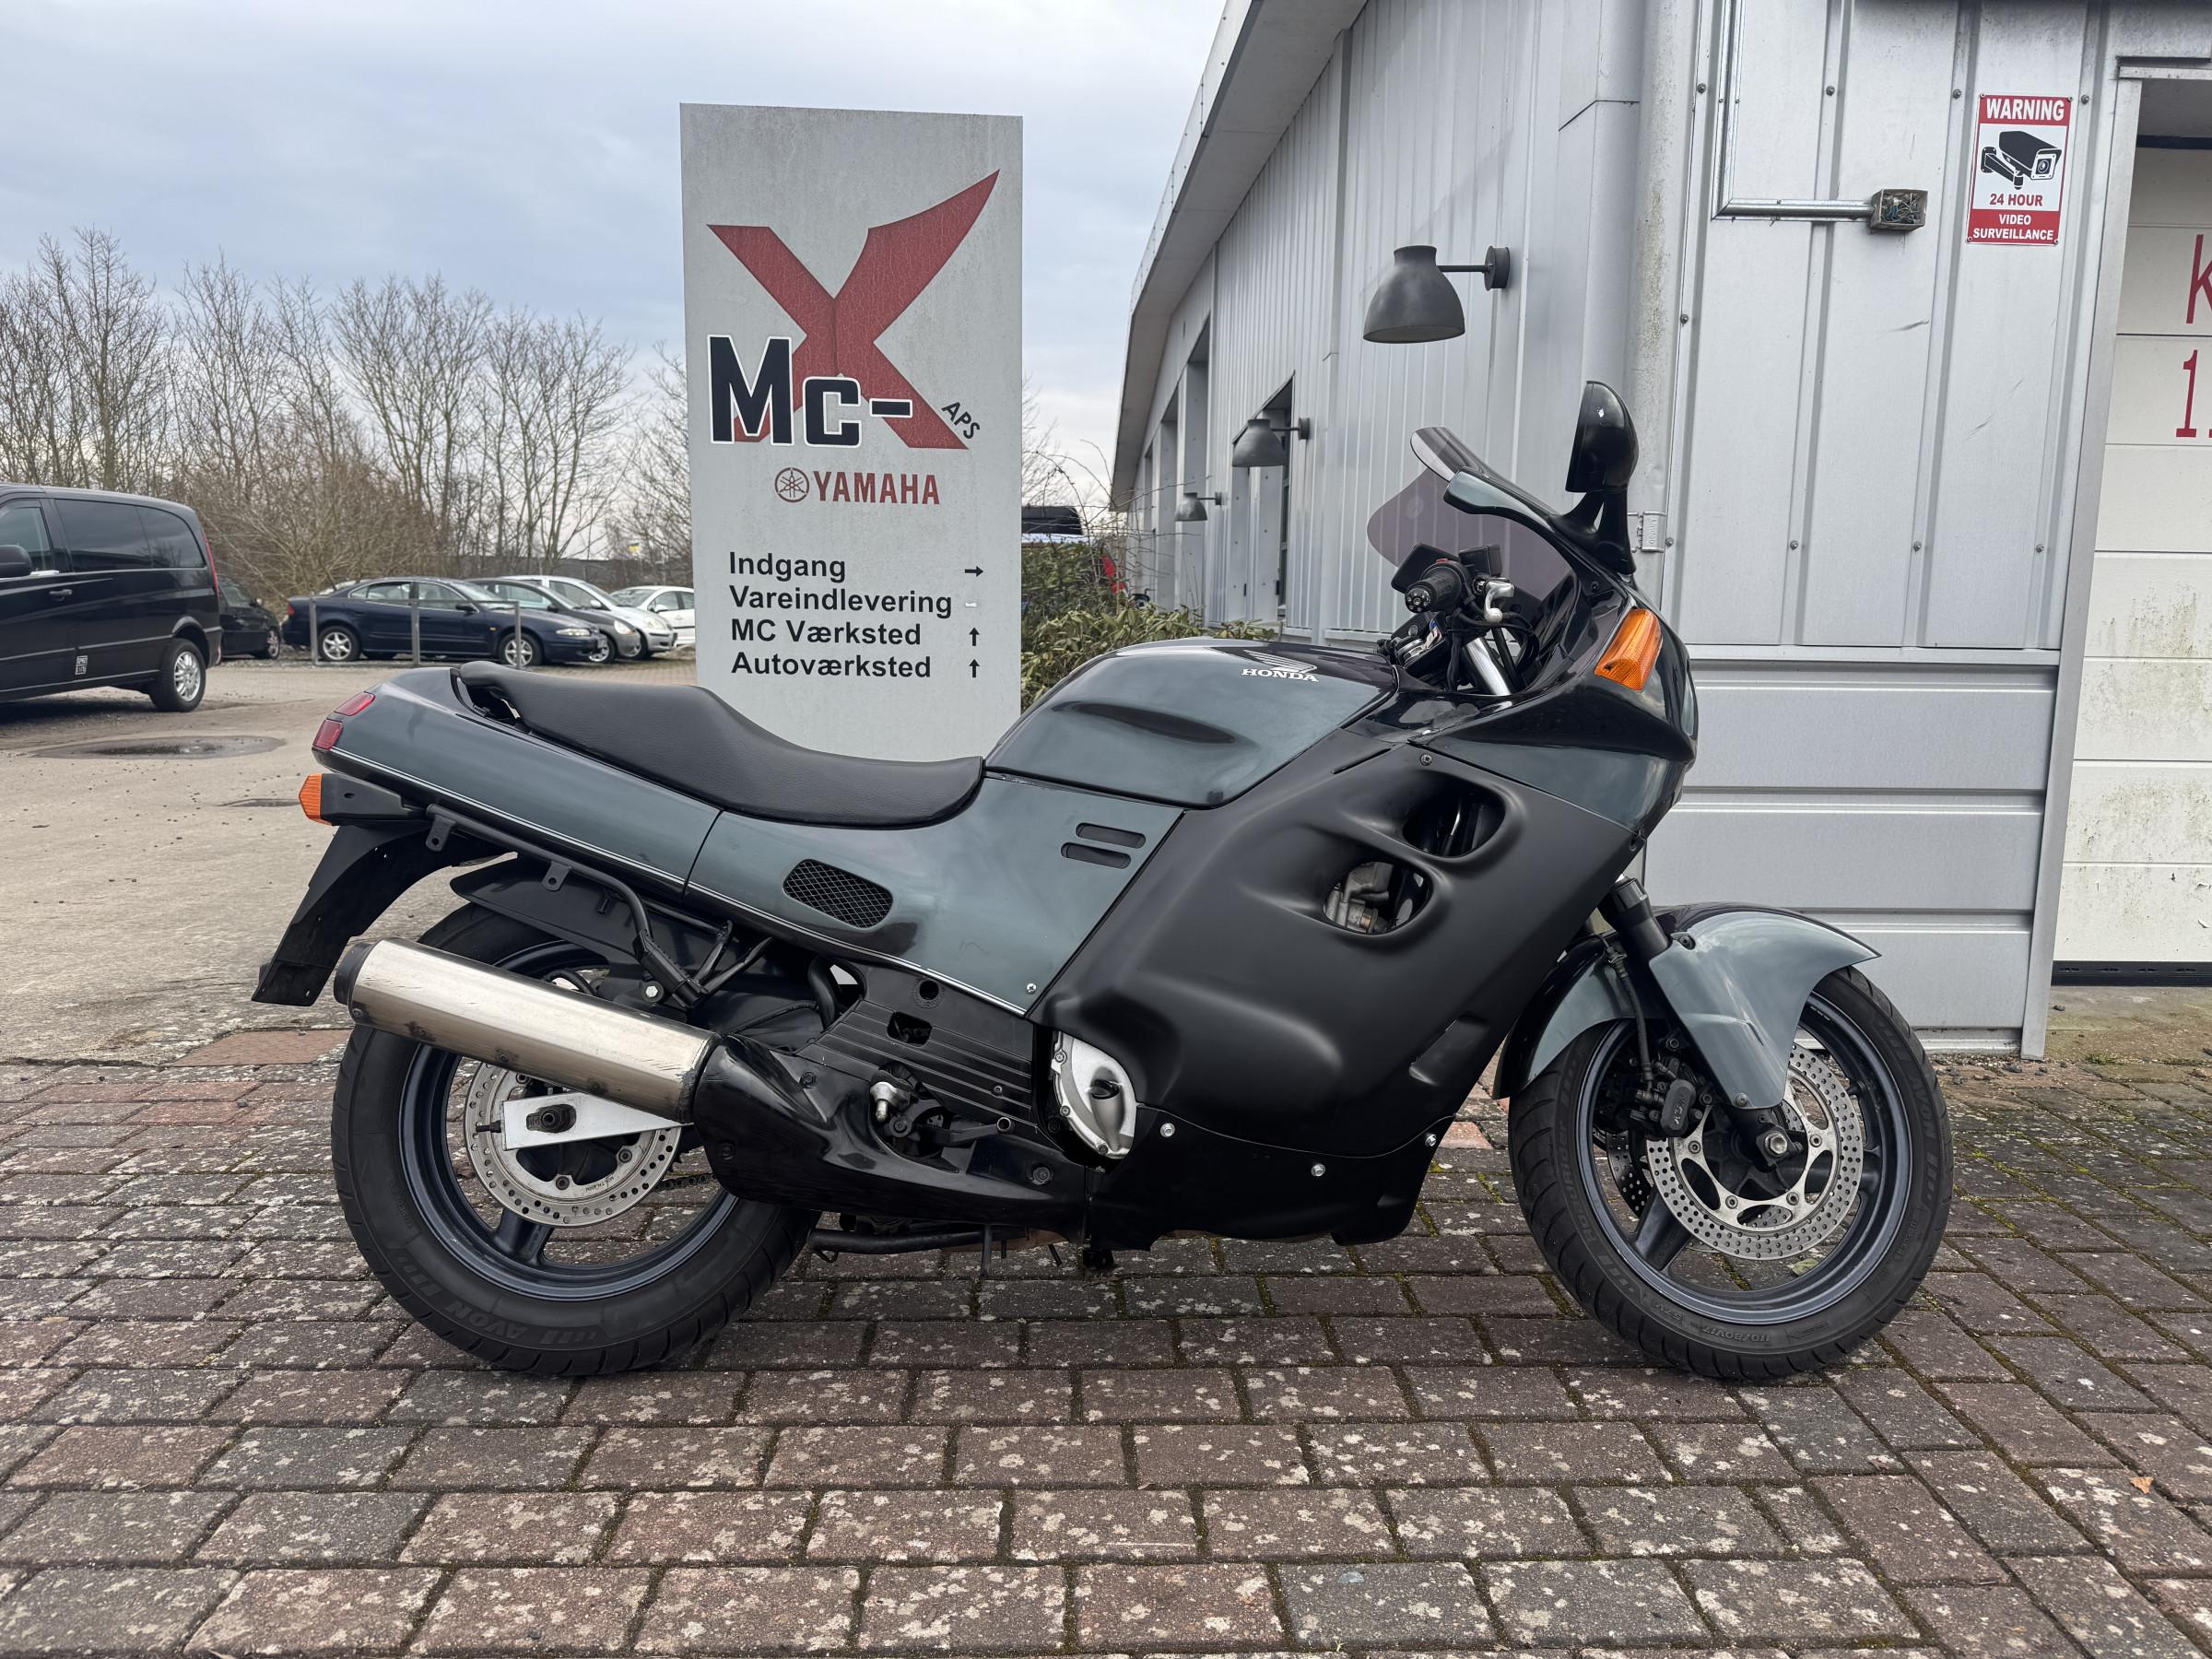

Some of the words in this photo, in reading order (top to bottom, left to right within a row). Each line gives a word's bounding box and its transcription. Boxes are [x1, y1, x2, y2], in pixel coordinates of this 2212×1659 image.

[1986, 98, 2065, 121] WARNING
[1989, 193, 2005, 206] 24
[2007, 194, 2043, 206] HOUR
[1998, 214, 2032, 226] VIDEO
[1972, 228, 2054, 241] SURVEILLANCE
[941, 400, 981, 441] APS
[813, 470, 940, 505] YAMAHA
[729, 551, 846, 583] Indgang
[729, 584, 953, 619] Vareindlevering
[731, 618, 776, 642] MC
[785, 620, 922, 645] Værksted
[731, 652, 932, 678] Autoværksted
[1241, 668, 1320, 683] HONDA
[445, 1300, 530, 1339] AVON
